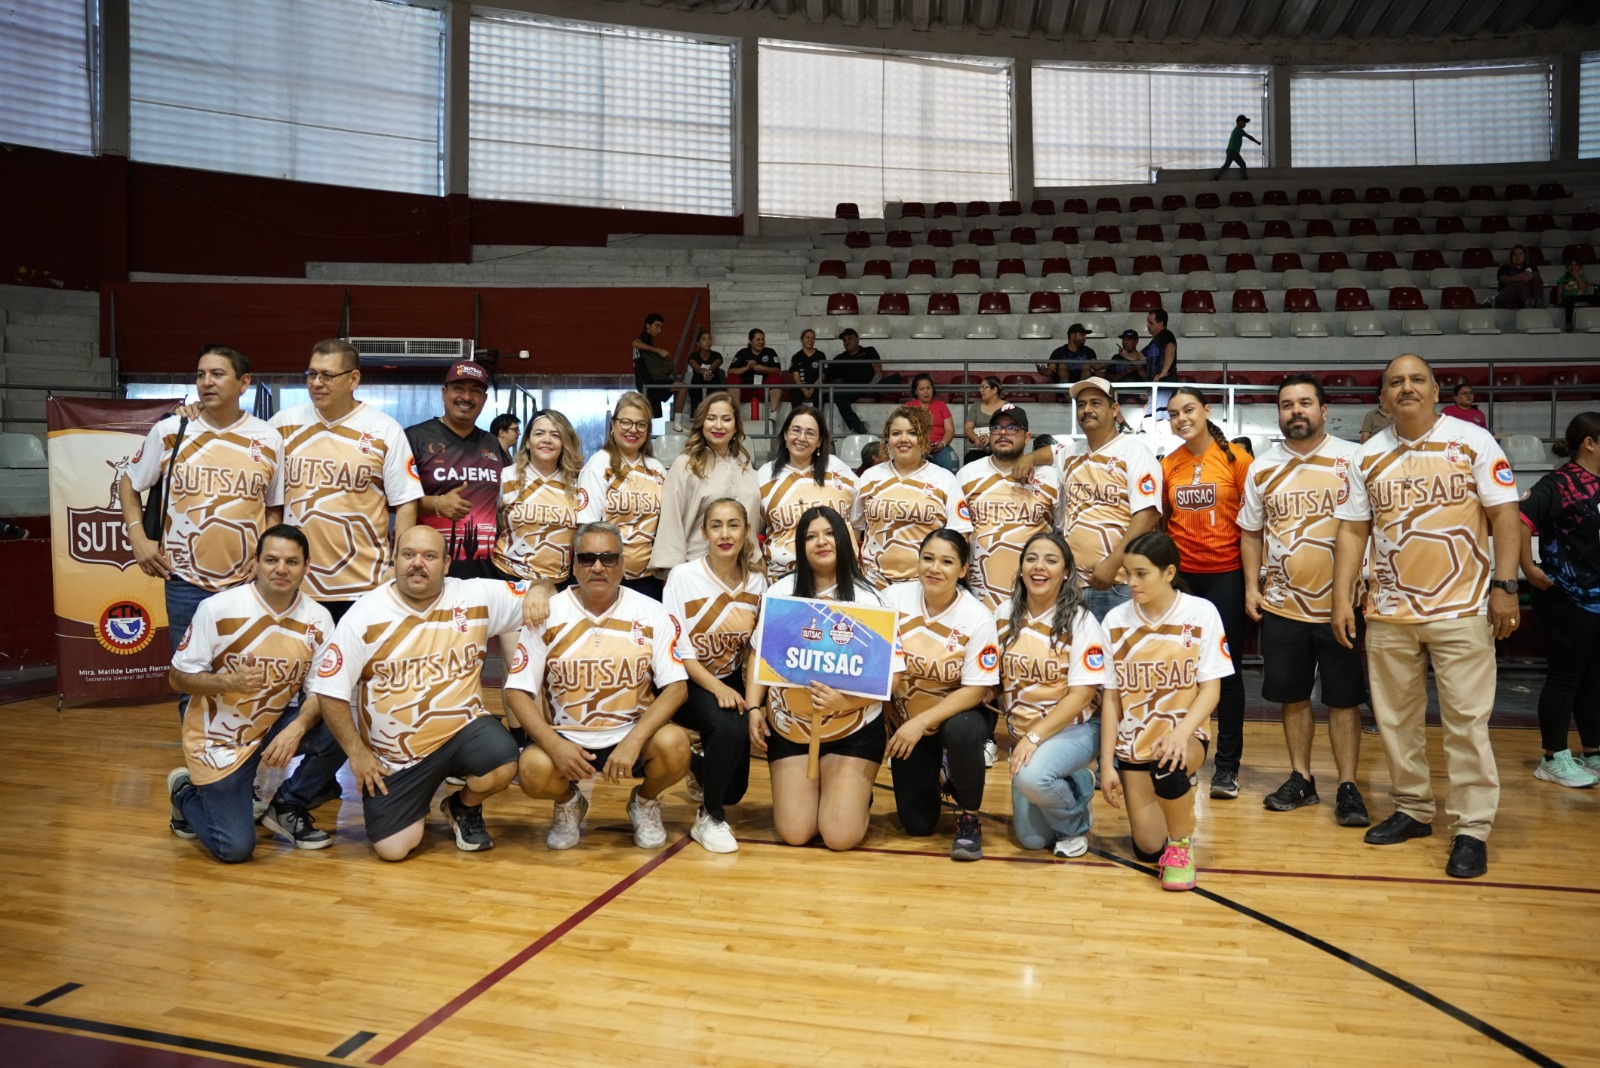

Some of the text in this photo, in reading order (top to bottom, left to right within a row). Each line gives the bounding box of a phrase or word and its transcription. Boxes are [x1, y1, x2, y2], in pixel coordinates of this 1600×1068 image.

[173, 463, 265, 499] SUTSAC
[433, 466, 498, 483] CAJEME
[607, 489, 662, 516] SUTSA
[1177, 488, 1213, 505] SUTSAC
[1367, 473, 1468, 512] SUTSAC
[1209, 510, 1216, 527] 1
[77, 521, 134, 553] SUTS
[108, 604, 142, 618] CTM
[693, 632, 752, 661] SUTS
[802, 629, 822, 640] SUTSAC
[149, 664, 171, 672] Fierros
[372, 642, 480, 693] SUTSAC
[548, 656, 653, 691] SUTSAC
[785, 646, 864, 677] SUTSAC
[902, 651, 961, 682] TSAC
[1113, 658, 1197, 693] SUTSAC
